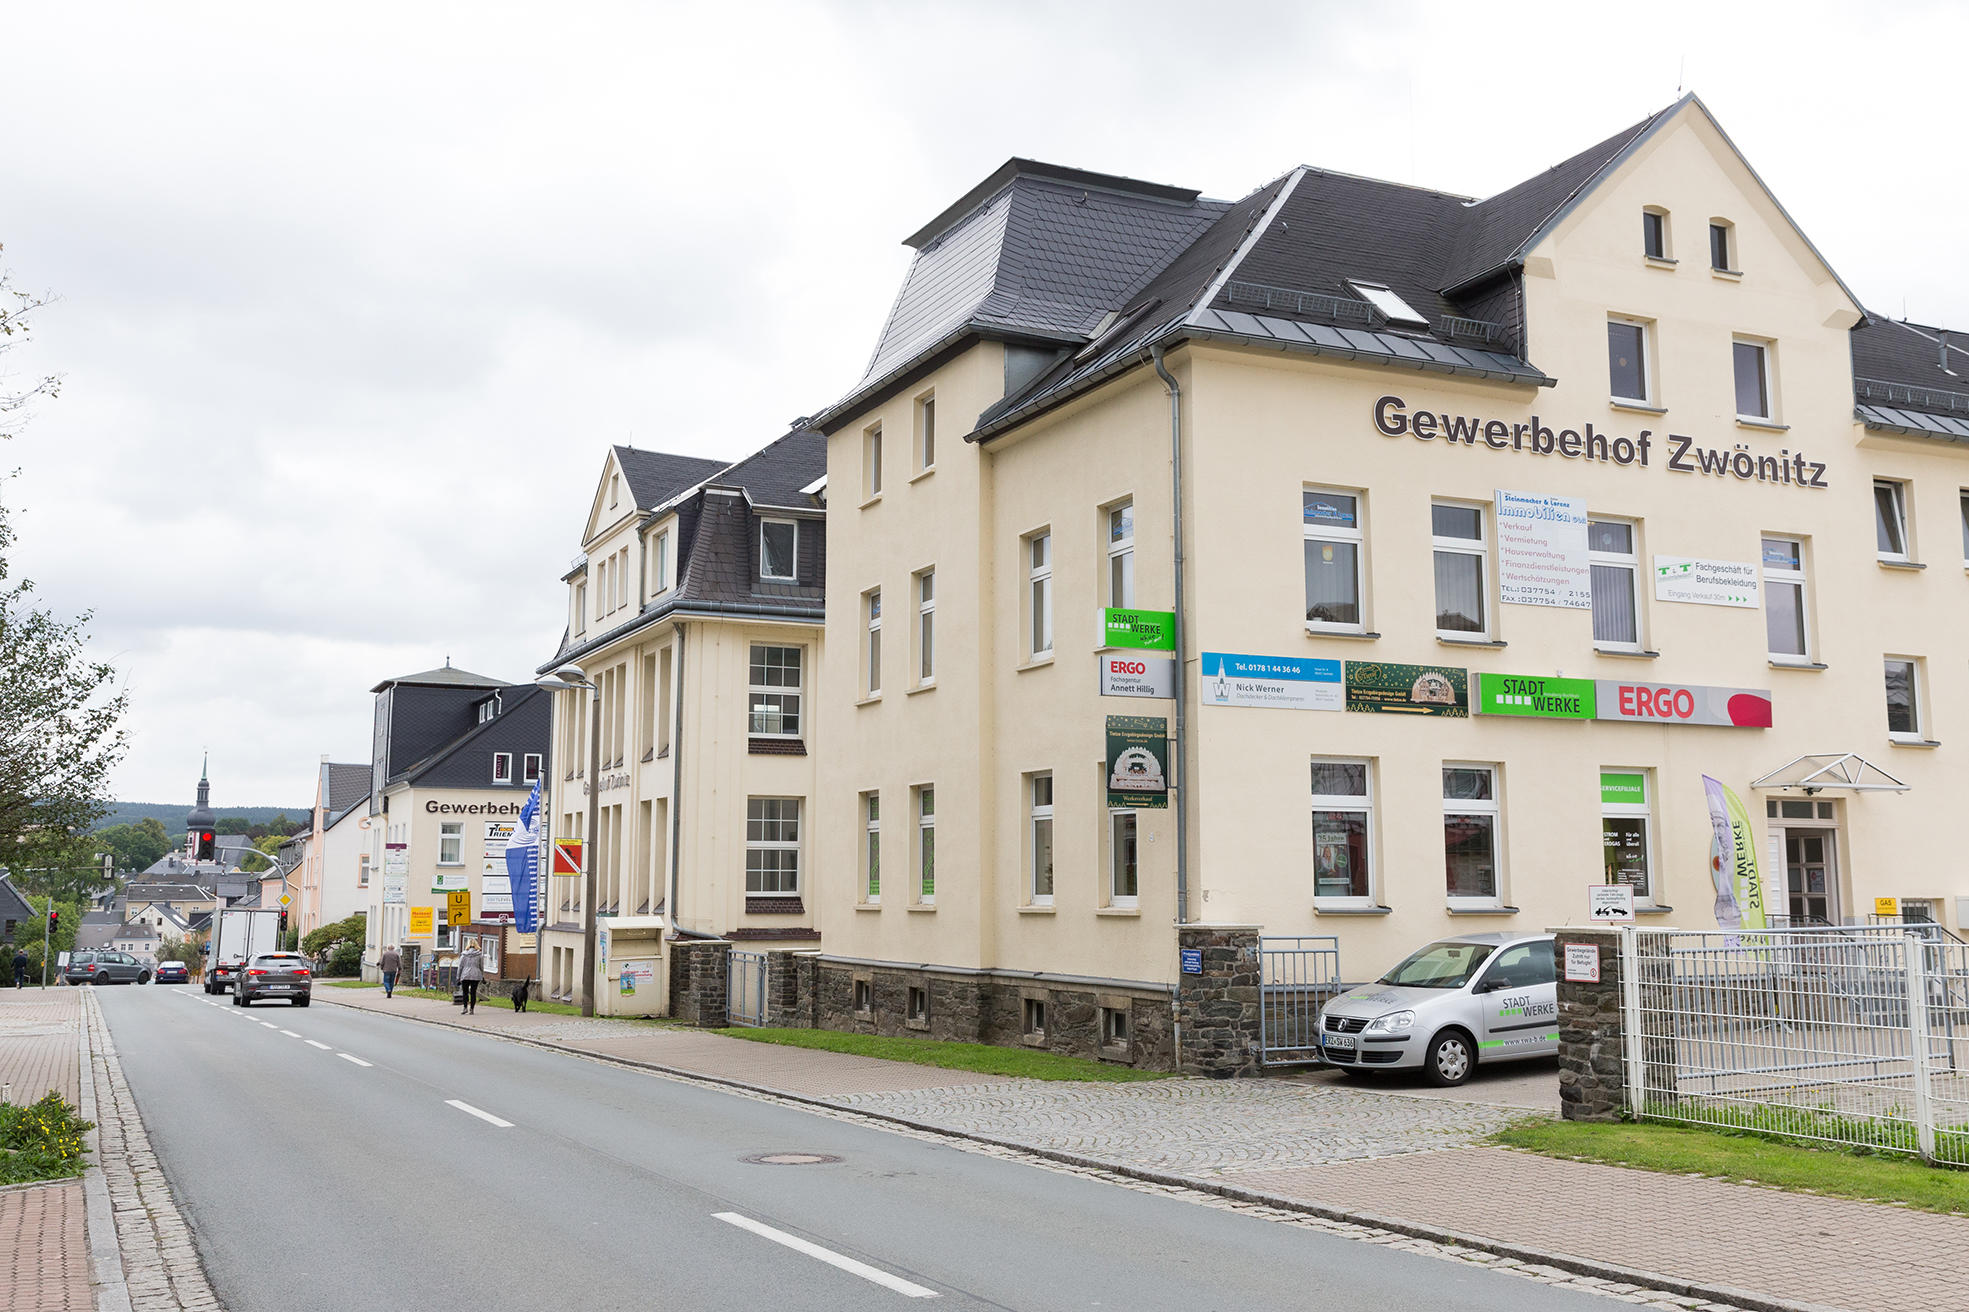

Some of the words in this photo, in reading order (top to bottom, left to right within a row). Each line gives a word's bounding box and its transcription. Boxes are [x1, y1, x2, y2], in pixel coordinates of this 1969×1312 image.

[1374, 395, 1652, 467] Gewerbehof
[1667, 433, 1829, 488] Zwönitz
[1496, 489, 1571, 523] Immobilien
[1504, 495, 1541, 505] Steinmacher
[1503, 522, 1532, 531] Verkauf
[1504, 534, 1548, 547] Vermietung
[1505, 548, 1566, 561] Hausverwaltung
[1505, 560, 1590, 575] Finanzdienstleistungen
[1695, 562, 1742, 575] Fachgeschäft
[1743, 567, 1753, 575] für
[1696, 575, 1757, 589] Berufsbekleidung
[1568, 590, 1591, 598] 2155
[1668, 590, 1691, 600] Eingang
[1692, 592, 1712, 600] Verkauf
[1563, 600, 1591, 608] 74647
[1112, 613, 1139, 624] STADT
[1131, 624, 1161, 634] WERKE
[1110, 661, 1146, 675] ERGO
[1235, 662, 1247, 671] Tel.
[1248, 664, 1266, 672] 0178
[1272, 665, 1281, 673] 44
[1292, 666, 1301, 674] 46
[1110, 676, 1141, 684] Fachagentur
[1110, 684, 1135, 692] Annett
[1136, 685, 1155, 695] Hillig
[1236, 684, 1254, 692] Nick
[1255, 685, 1285, 694] Werner
[1503, 679, 1545, 695] STADT
[1532, 697, 1581, 713] WERKE
[1618, 685, 1695, 719] ERGO
[425, 800, 523, 815] Gewerbeh
[455, 895, 463, 904] U
[1503, 995, 1530, 1009] STADT
[1523, 1003, 1554, 1017] WERKE
